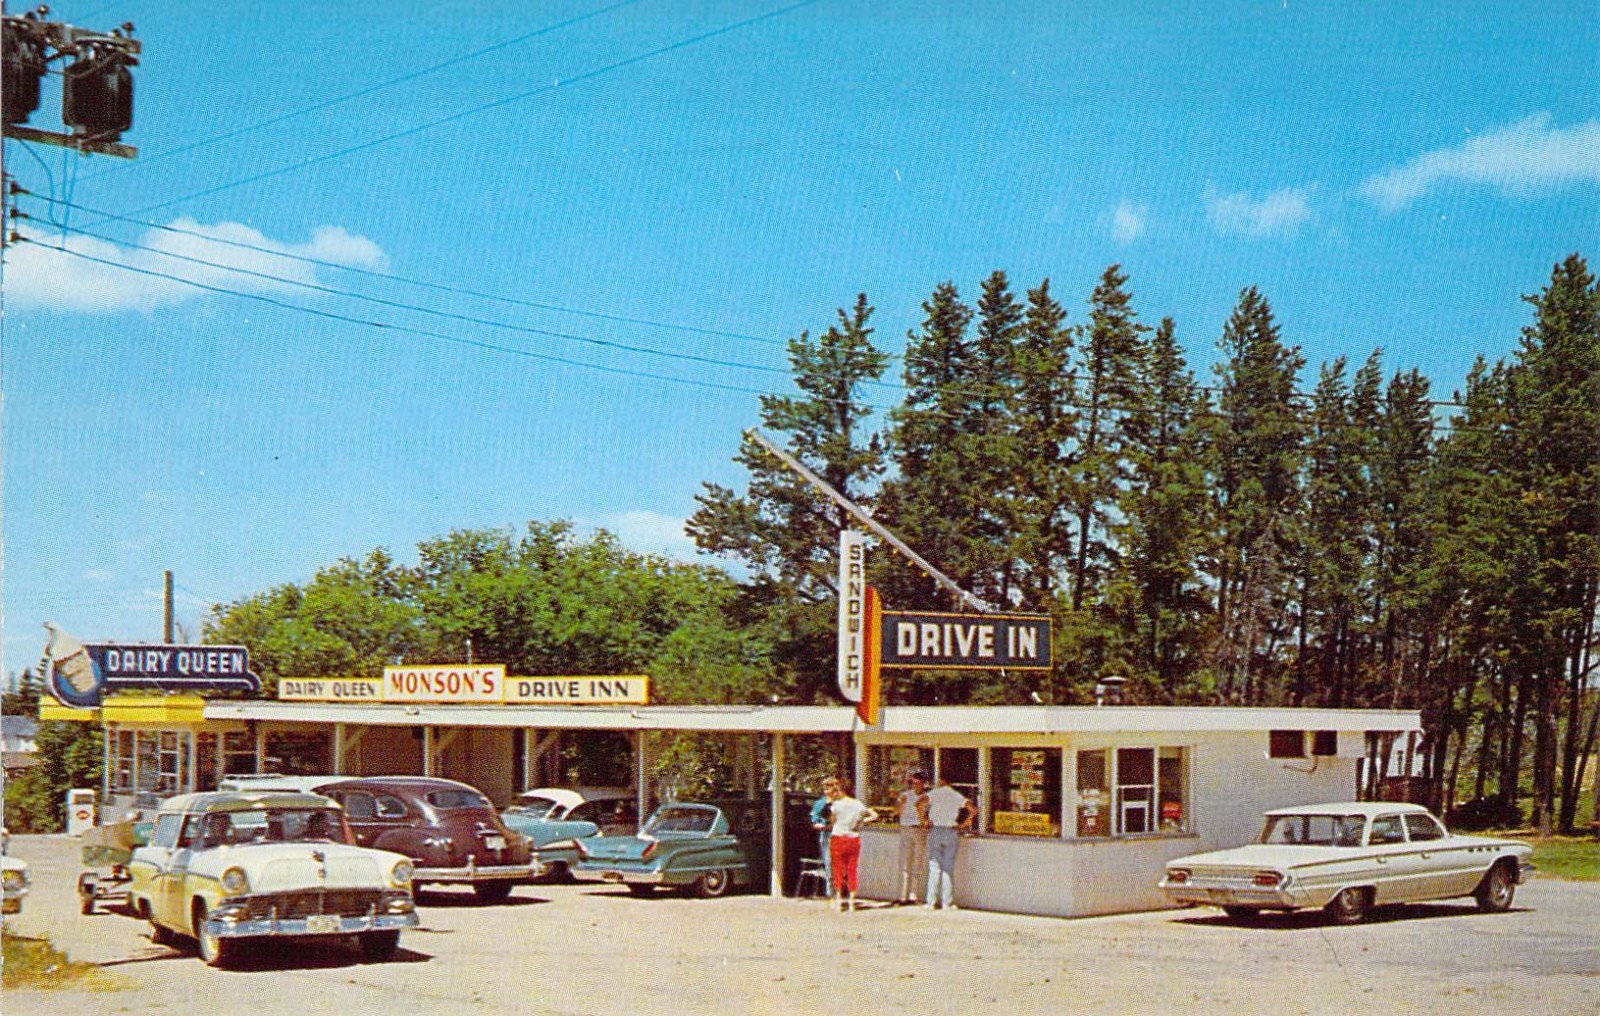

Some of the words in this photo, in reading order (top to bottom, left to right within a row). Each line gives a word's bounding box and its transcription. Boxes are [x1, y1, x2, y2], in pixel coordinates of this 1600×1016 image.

[846, 544, 861, 689] SANDWICH
[897, 622, 995, 658] DRIVE
[1008, 626, 1038, 659] IN
[108, 650, 170, 672] DAIRY
[177, 652, 244, 675] QUEEN
[285, 681, 323, 696] DAIRY
[332, 682, 375, 698] QUEEN
[389, 670, 495, 695] MONSON'S
[518, 681, 580, 698] DRIVE
[590, 681, 629, 698] INN
